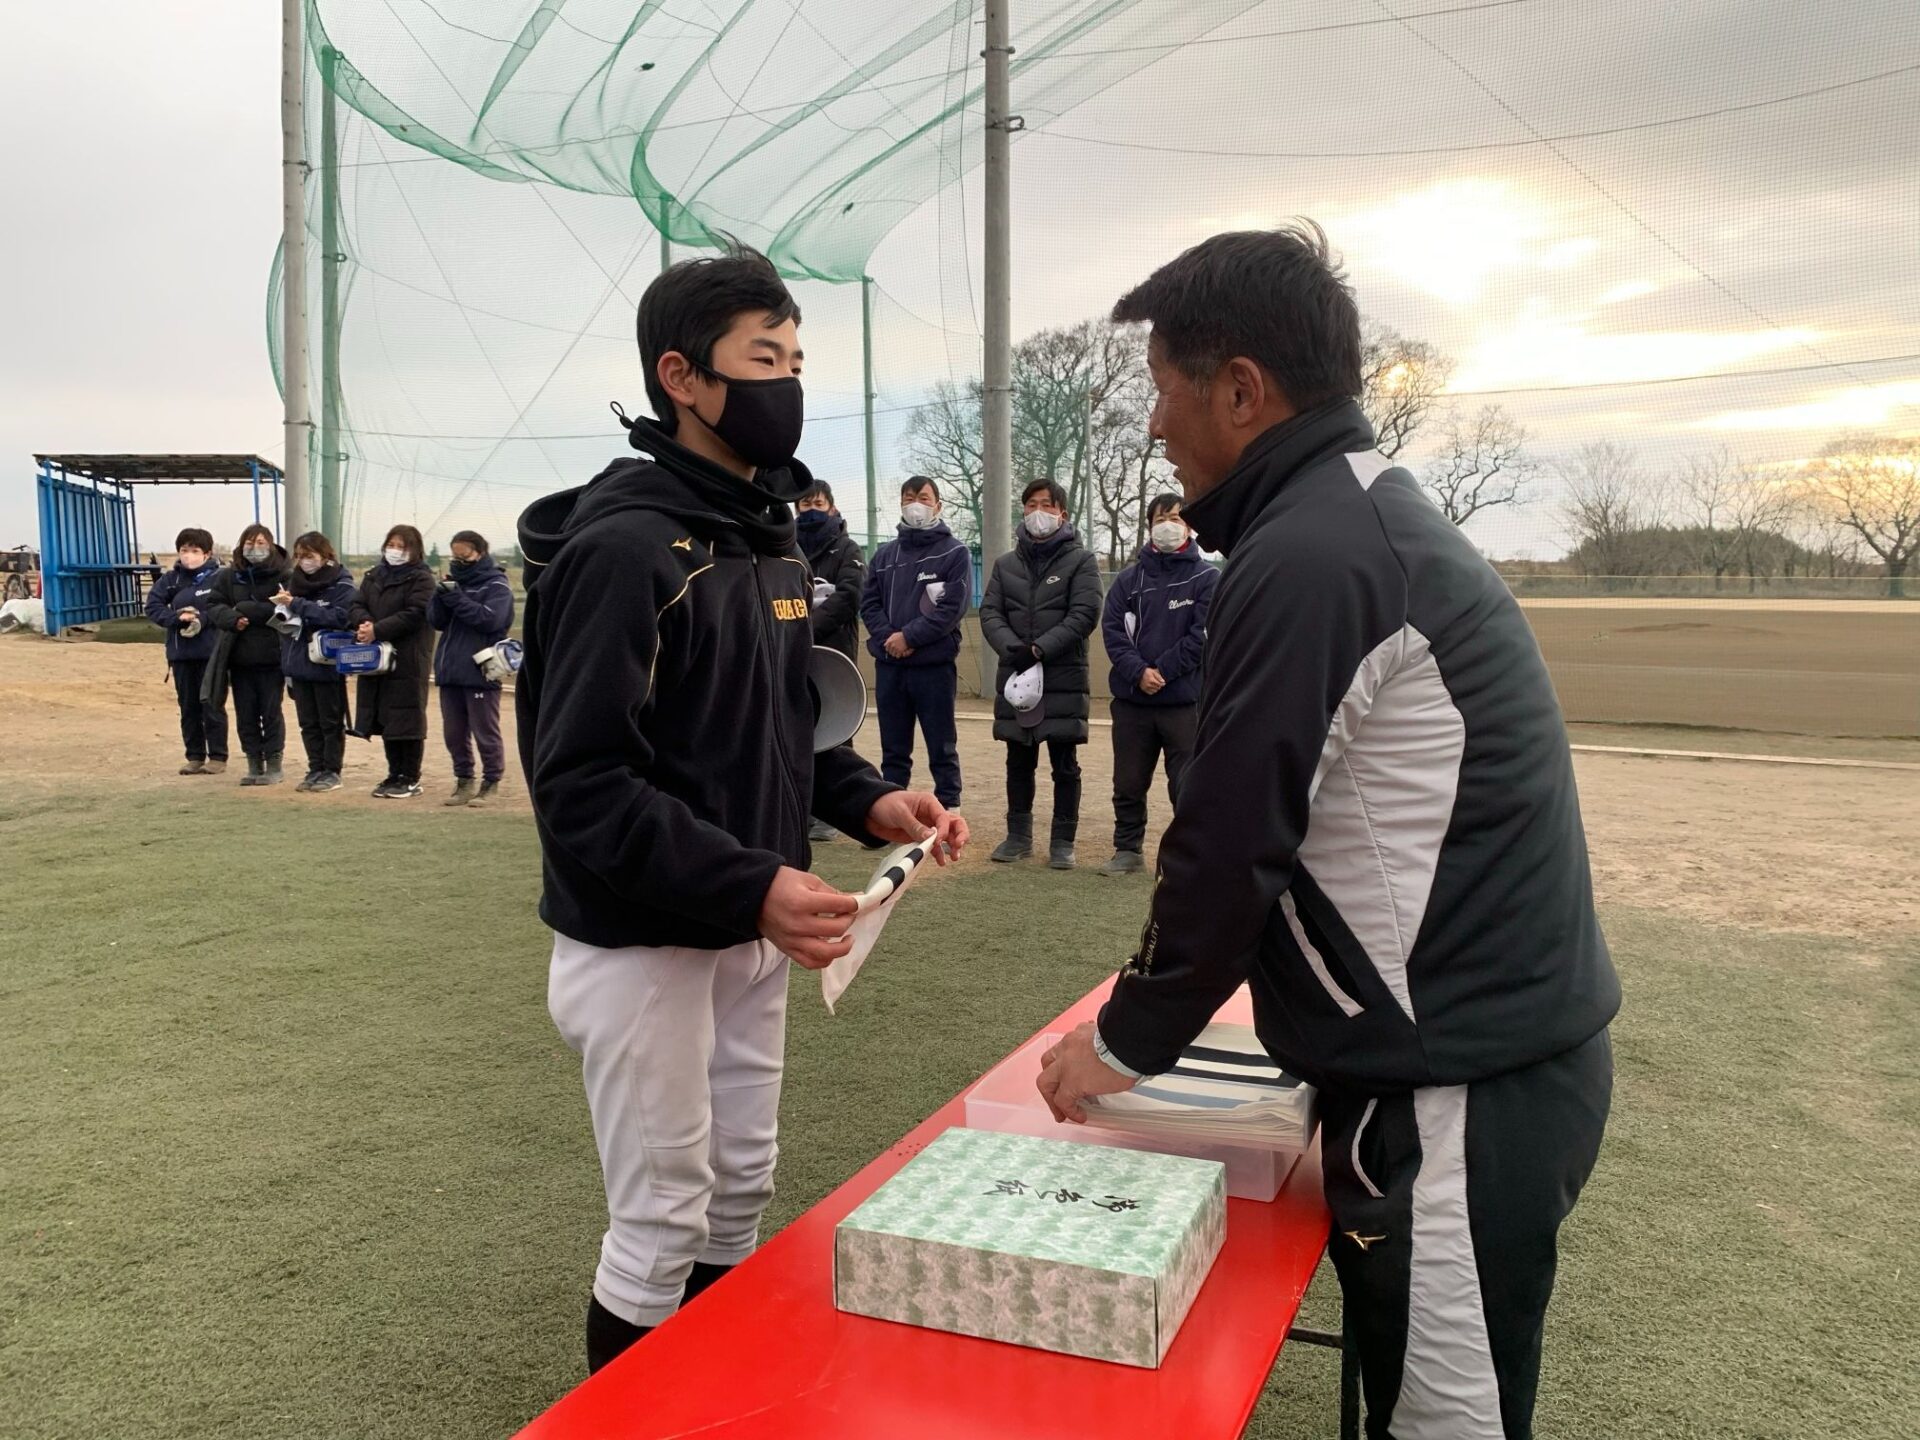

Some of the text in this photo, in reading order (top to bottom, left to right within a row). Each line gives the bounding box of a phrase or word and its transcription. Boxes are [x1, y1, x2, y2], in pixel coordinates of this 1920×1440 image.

[1145, 922, 1160, 965] QUALITY
[982, 1178, 1145, 1213] 御色紙
